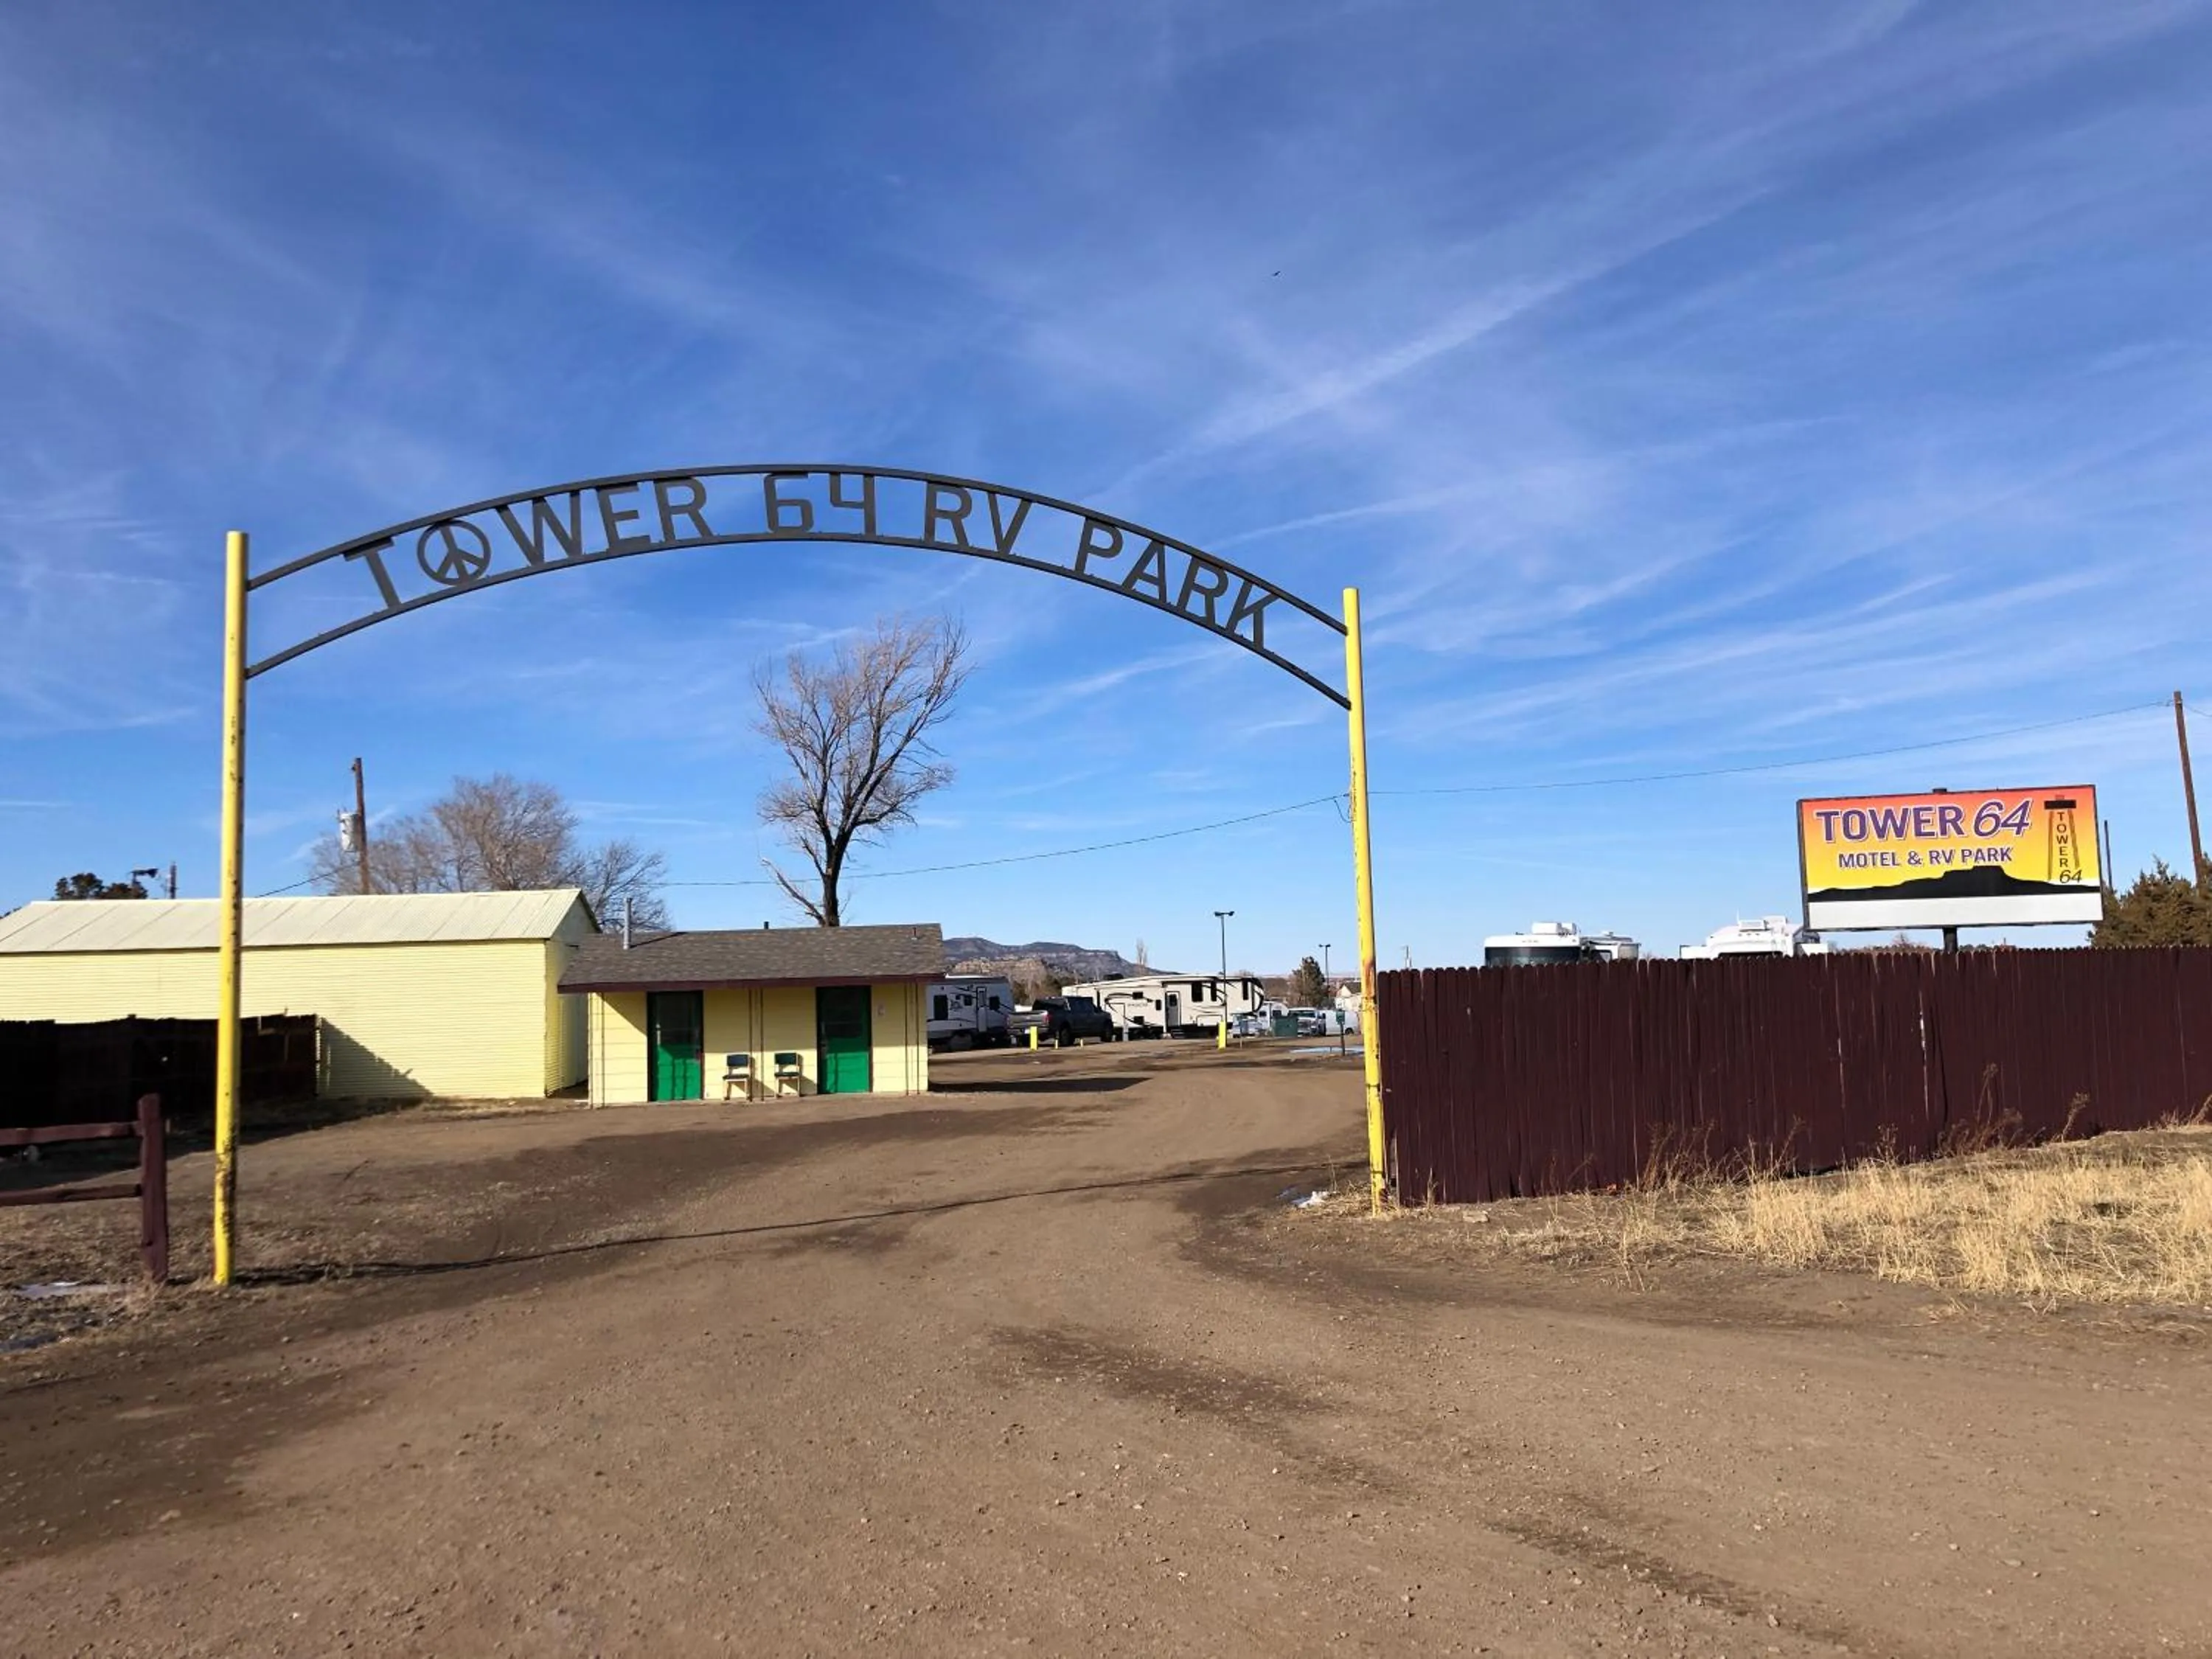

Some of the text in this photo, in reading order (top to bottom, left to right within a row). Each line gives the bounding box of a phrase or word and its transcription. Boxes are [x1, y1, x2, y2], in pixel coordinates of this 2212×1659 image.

[763, 473, 876, 536] 64
[923, 481, 1033, 556] RV
[1074, 516, 1281, 650] PARK
[1816, 799, 2033, 842] TOWER 64
[2056, 811, 2069, 868] TOWER
[1838, 846, 2013, 869] MOTEL & RV PARK
[2059, 869, 2083, 884] 64
